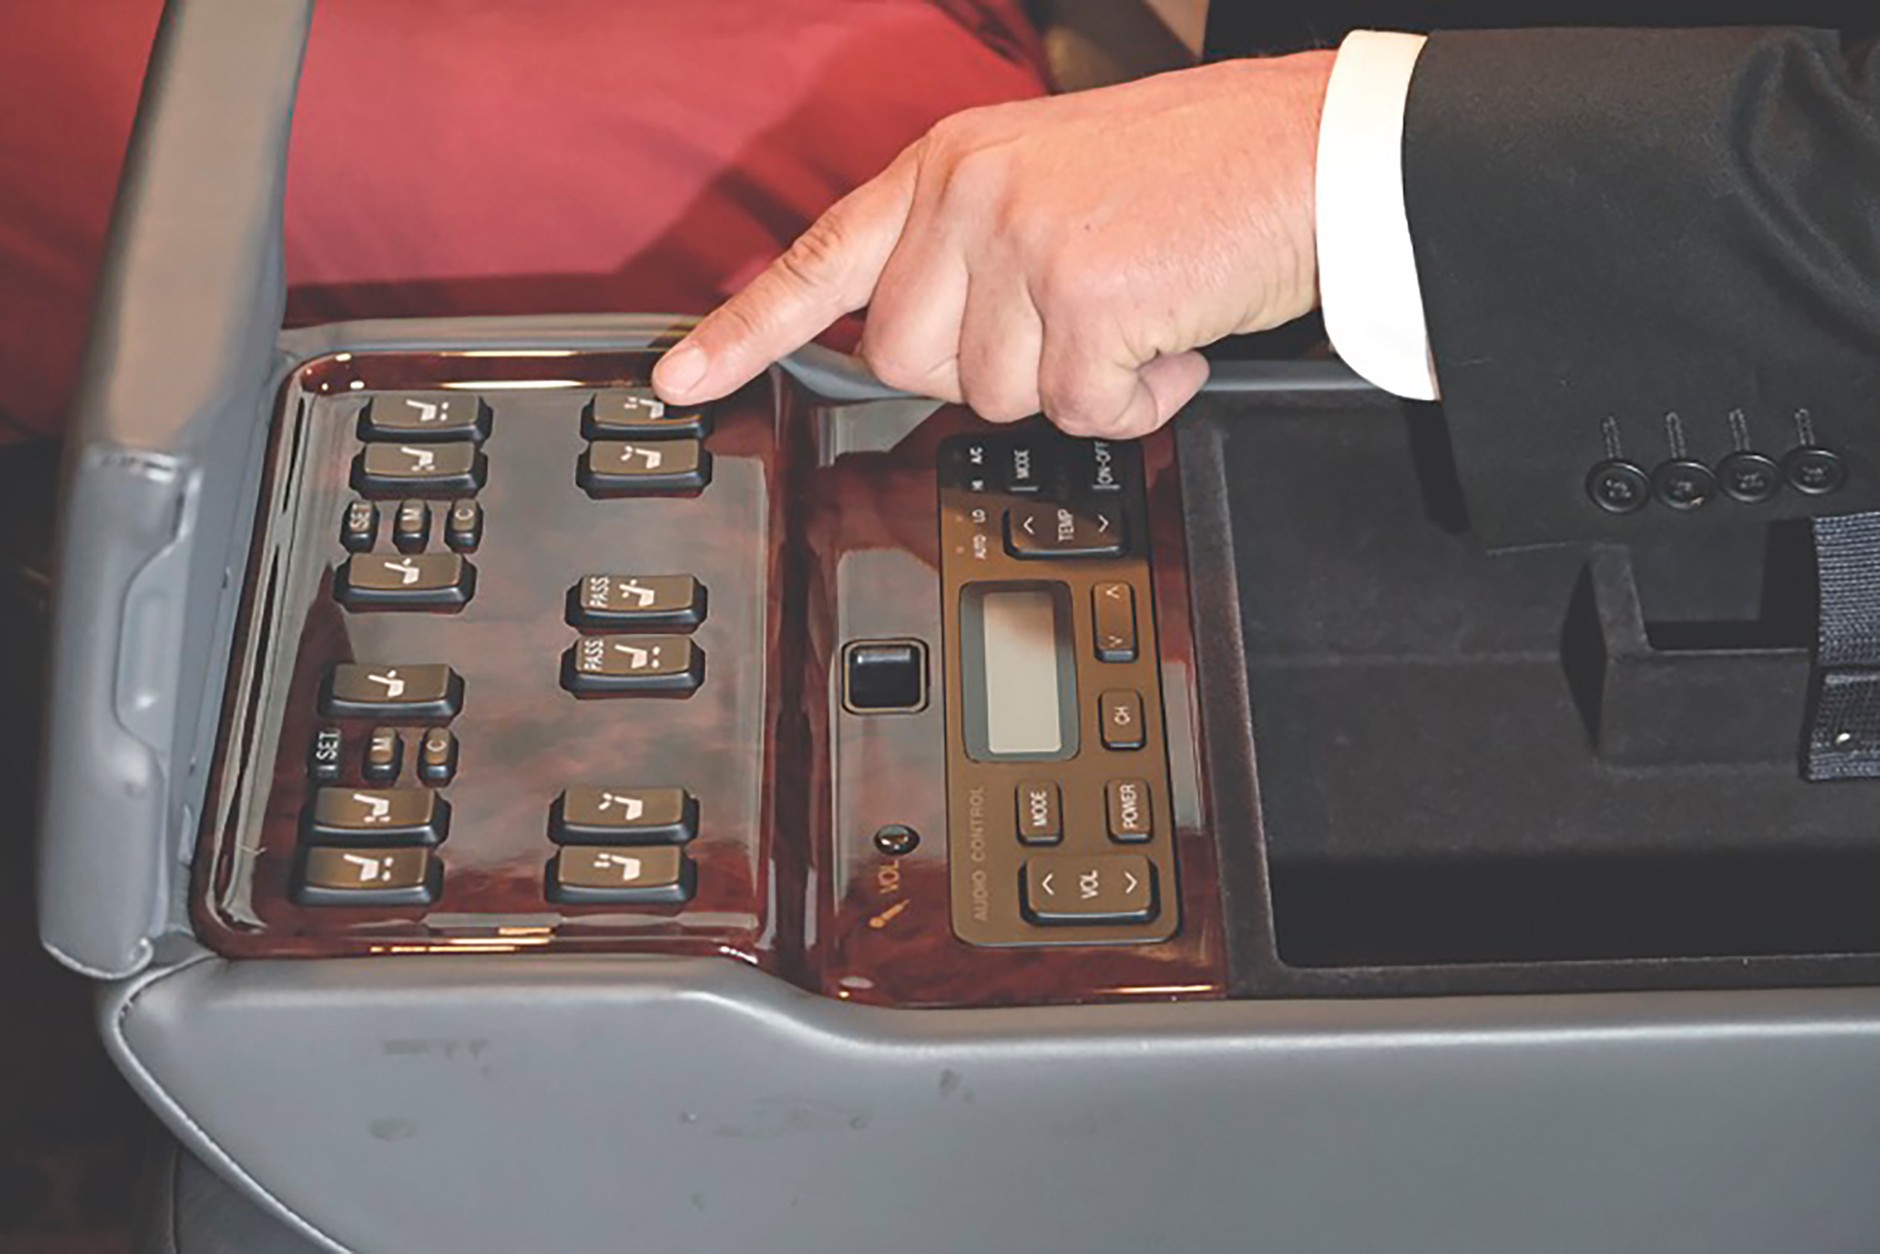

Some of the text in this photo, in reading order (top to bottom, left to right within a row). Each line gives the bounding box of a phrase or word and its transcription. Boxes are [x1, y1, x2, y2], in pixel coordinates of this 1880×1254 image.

[1014, 449, 1030, 479] MODE
[350, 502, 370, 531] SET
[402, 507, 421, 521] M
[972, 508, 985, 523] LO
[1057, 508, 1074, 541] TEMP
[973, 534, 987, 560] AUTO
[589, 577, 609, 608] PASS
[584, 640, 604, 671] PASS
[1114, 706, 1131, 725] CH
[315, 731, 339, 760] SET
[371, 737, 392, 751] M
[1030, 791, 1047, 826] MODE
[1119, 784, 1139, 829] POWER
[970, 785, 988, 922] AUDIO CONTROL
[878, 859, 899, 894] VOL
[1080, 870, 1099, 899] VOL
